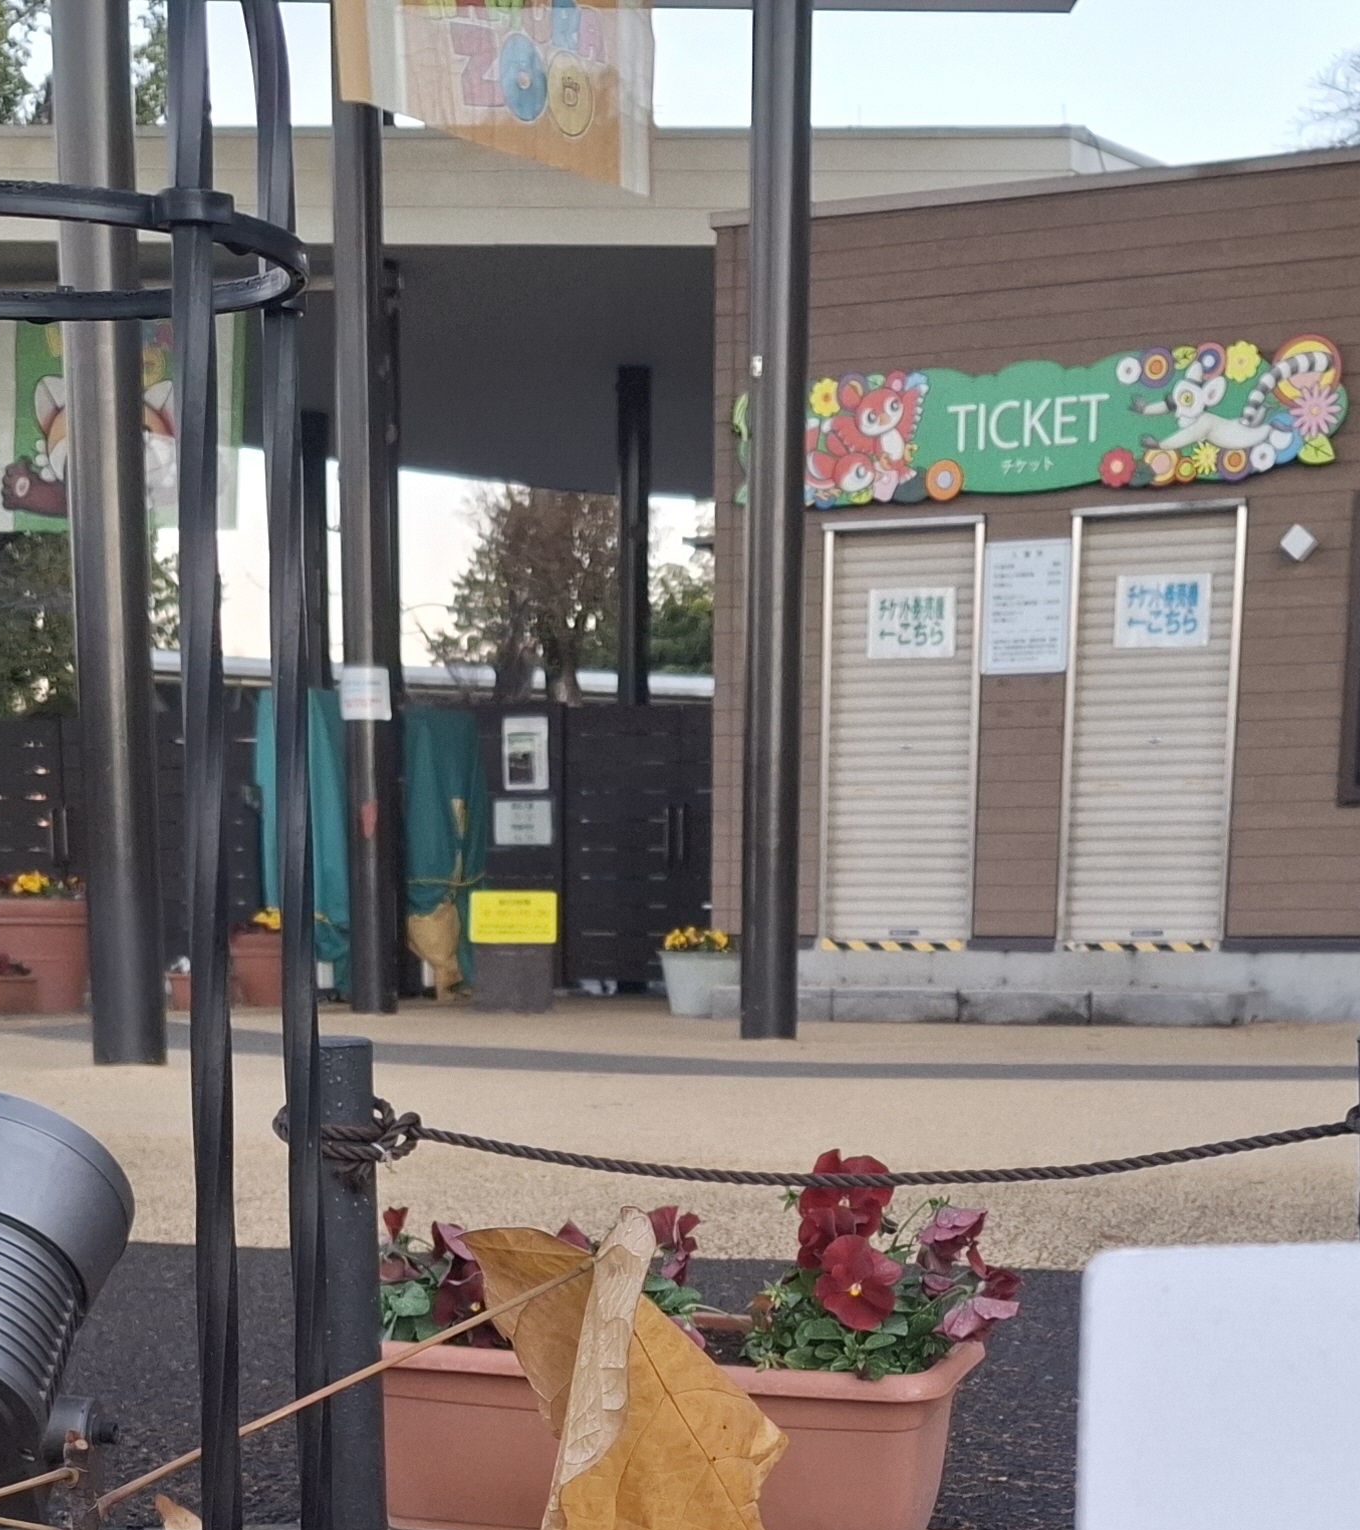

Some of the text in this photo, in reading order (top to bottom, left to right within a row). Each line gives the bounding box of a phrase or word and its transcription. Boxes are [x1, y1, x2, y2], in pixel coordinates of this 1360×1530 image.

[947, 393, 1111, 453] TICKET
[1001, 455, 1055, 475] チケット
[897, 621, 945, 646] こちら
[1147, 607, 1198, 635] こちら
